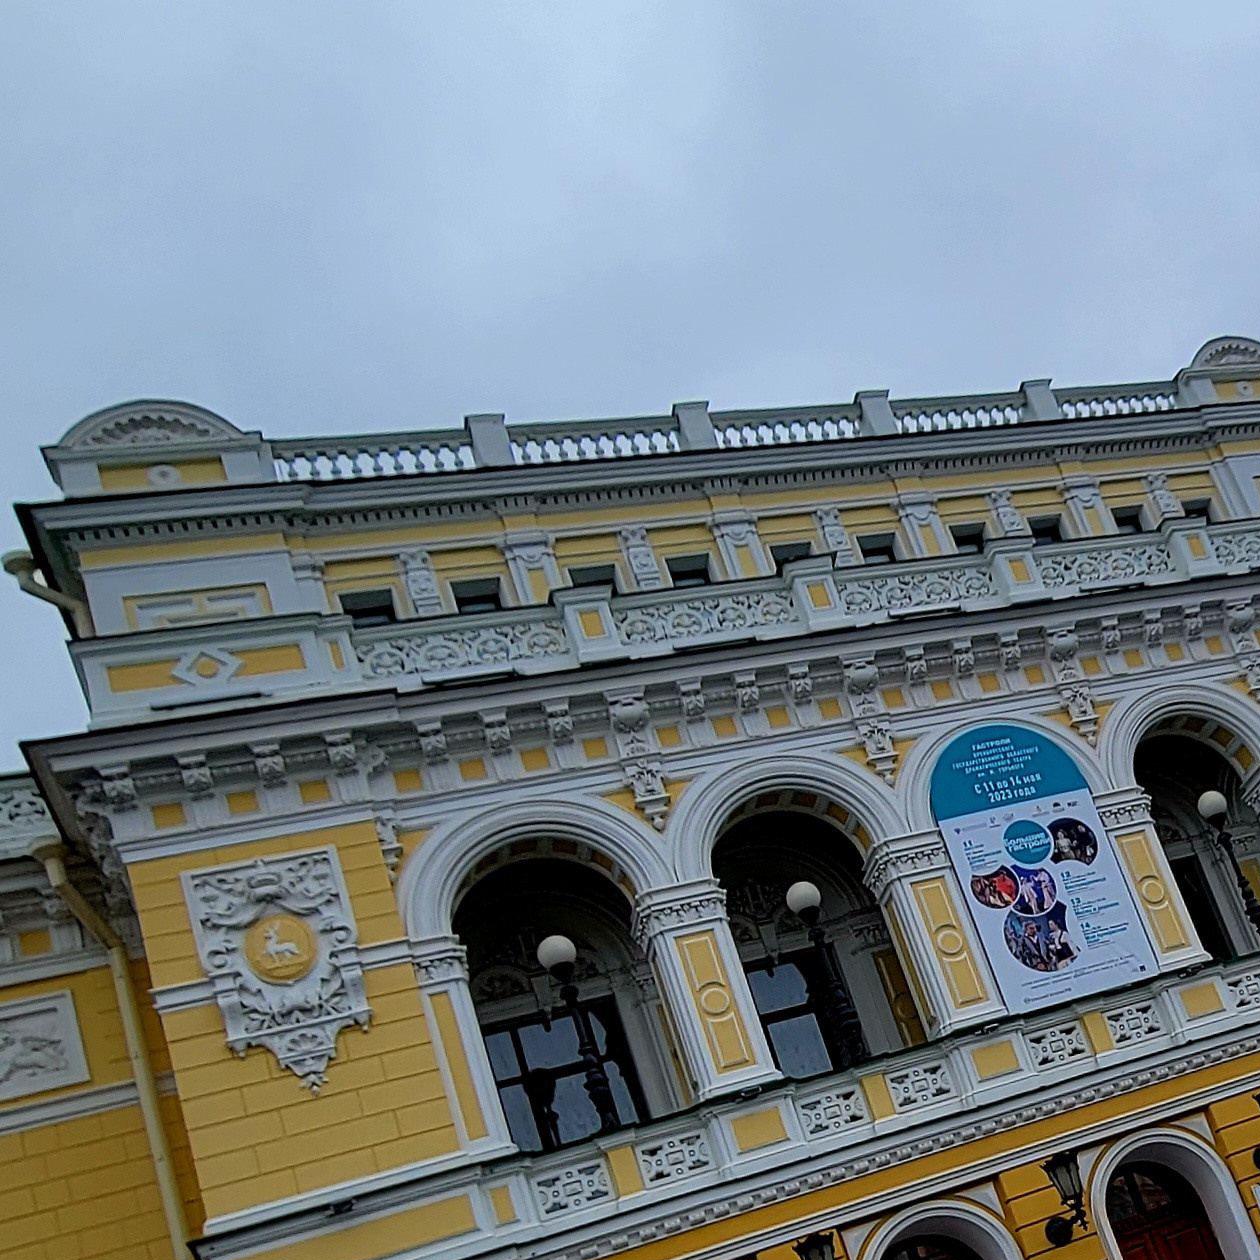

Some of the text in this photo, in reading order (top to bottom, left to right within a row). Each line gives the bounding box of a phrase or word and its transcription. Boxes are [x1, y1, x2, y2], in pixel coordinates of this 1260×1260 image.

[983, 781, 995, 792] 11
[996, 780, 1009, 790] по
[1009, 775, 1022, 786] 14
[1022, 773, 1042, 784] мая
[988, 786, 1037, 803] 2023 года
[1060, 870, 1071, 879] 12
[1070, 897, 1081, 905] 13
[1080, 921, 1091, 930] 14
